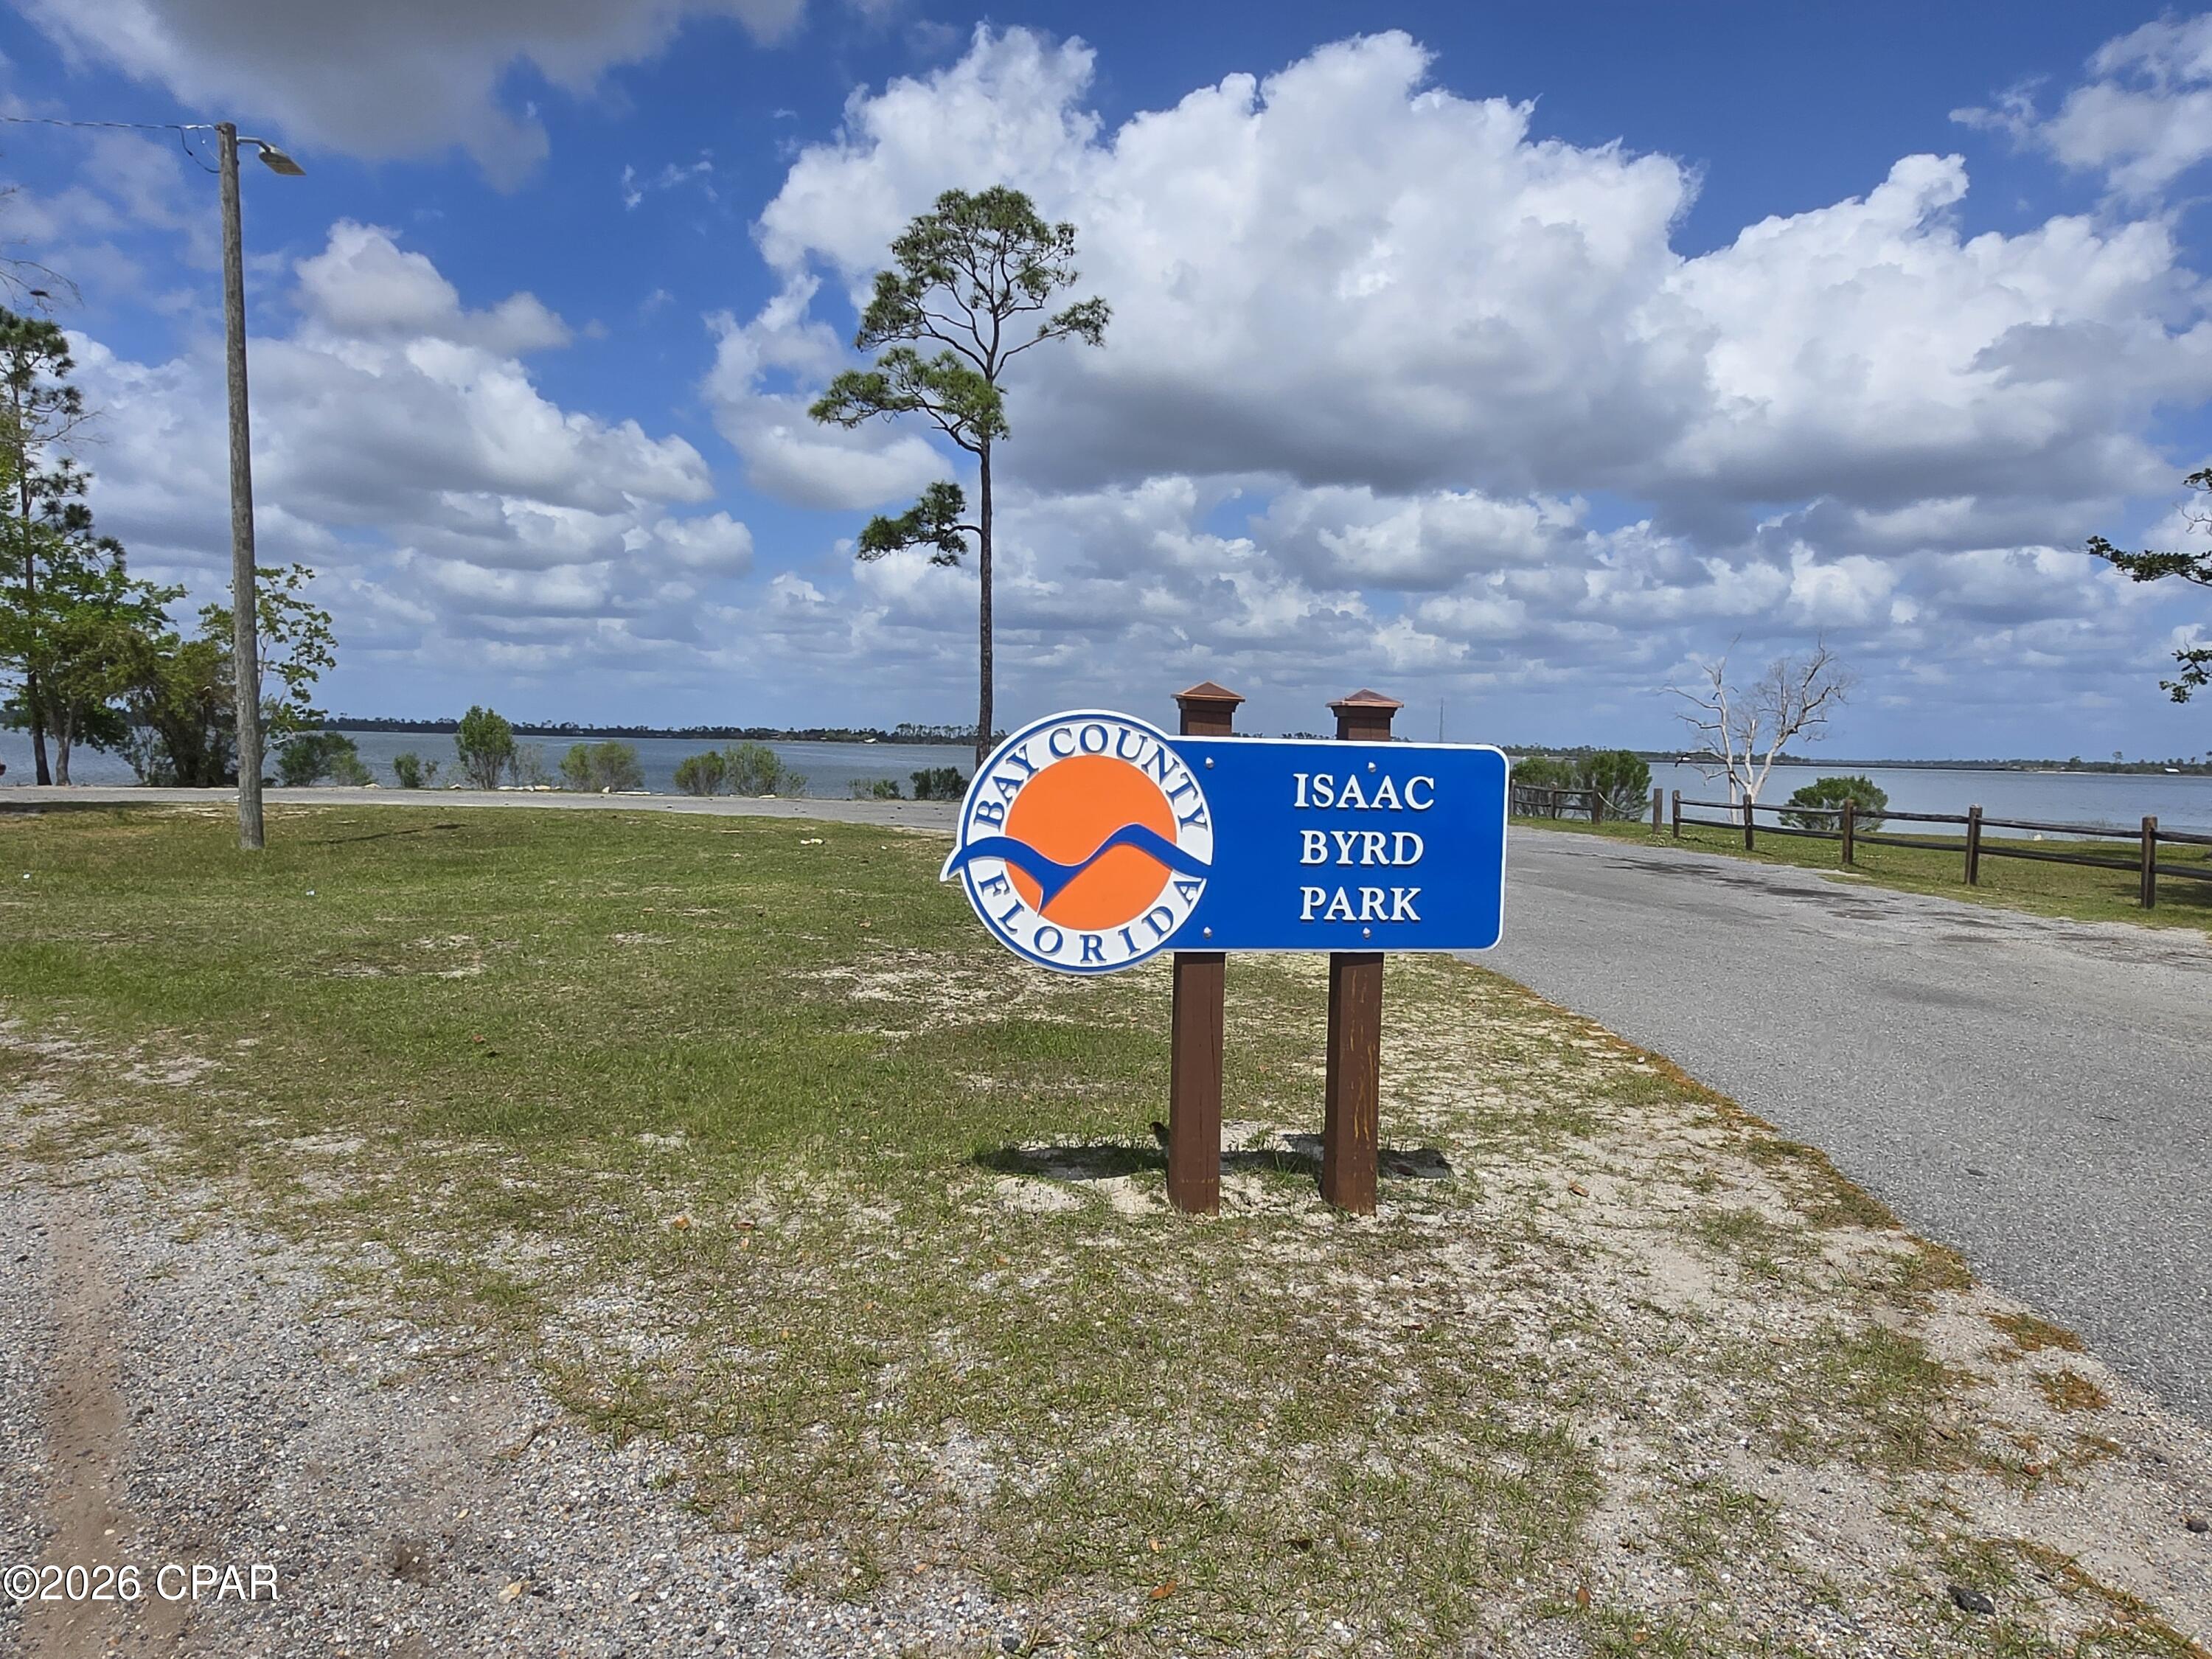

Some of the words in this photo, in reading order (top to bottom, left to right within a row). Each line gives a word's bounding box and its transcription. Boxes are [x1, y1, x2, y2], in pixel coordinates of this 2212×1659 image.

[973, 745, 1039, 832] BAY
[1049, 724, 1209, 832] COUNTY
[1293, 773, 1436, 811] ISAAC
[1300, 830, 1425, 867] BYRD
[978, 870, 1204, 964] FLORIDA
[1300, 886, 1422, 922] PARK
